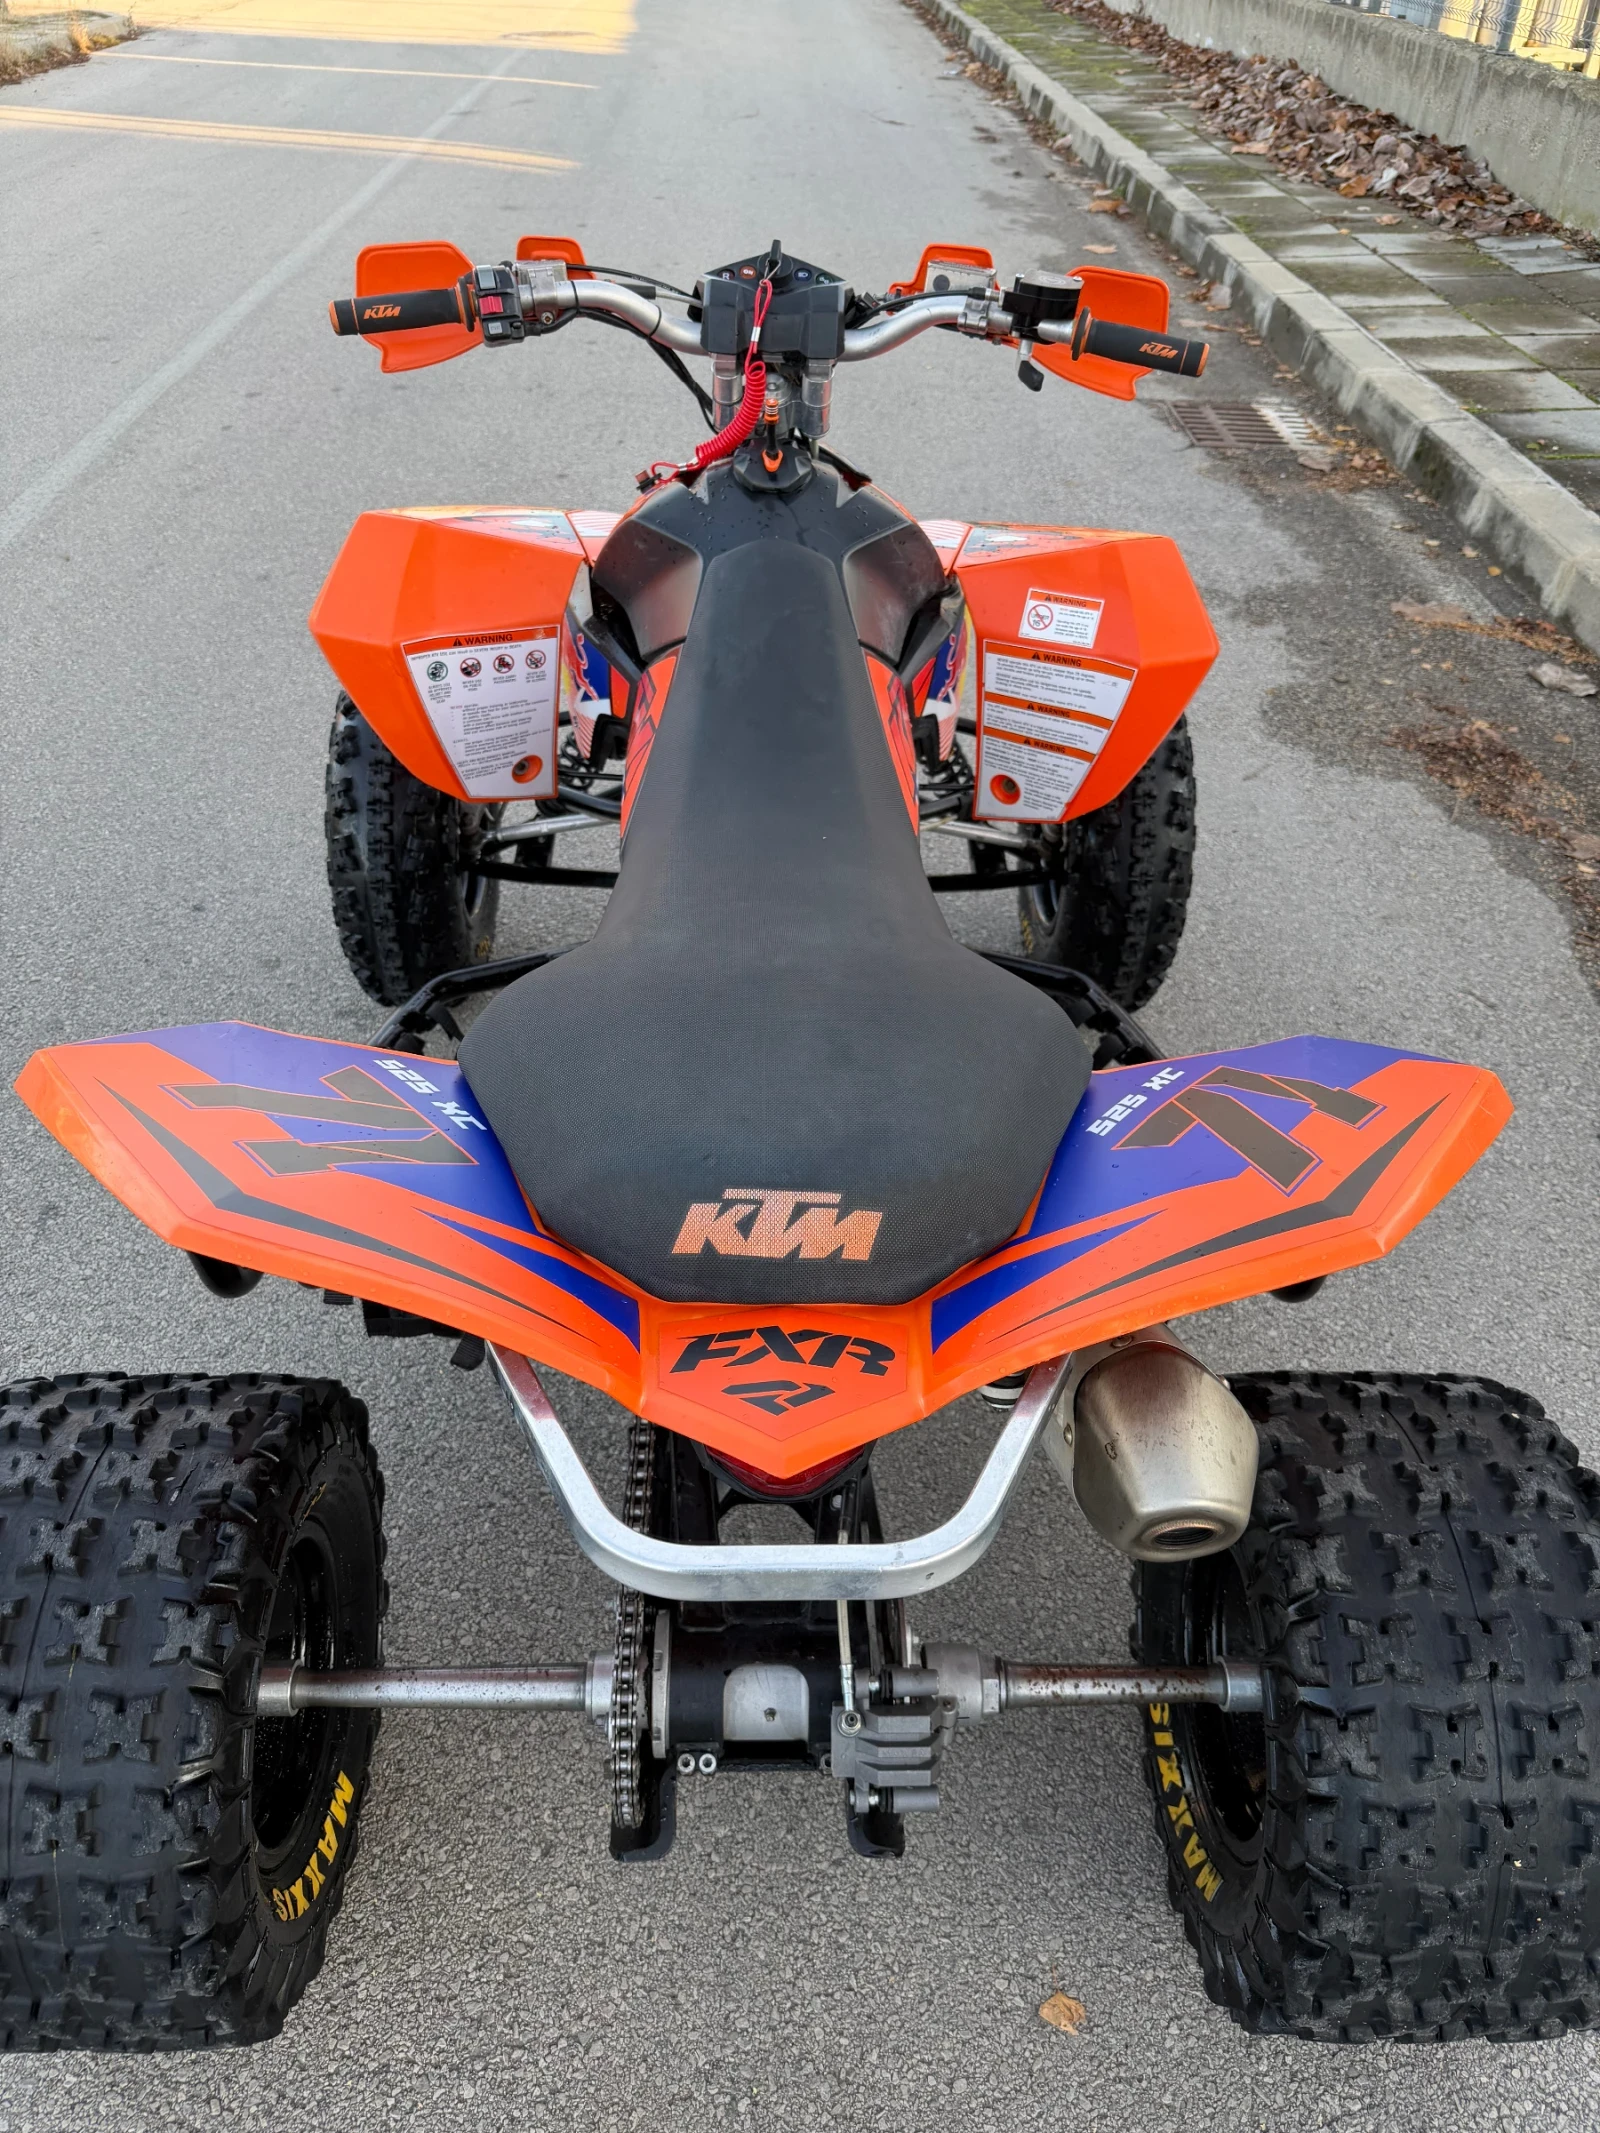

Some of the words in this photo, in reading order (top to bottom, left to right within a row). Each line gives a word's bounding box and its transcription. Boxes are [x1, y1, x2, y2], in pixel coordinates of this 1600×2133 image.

[722, 272, 730, 280] R
[363, 304, 401, 320] KTM
[1139, 341, 1178, 359] KTM
[1052, 597, 1087, 608] WARNING
[464, 634, 513, 646] WARNING
[1043, 654, 1082, 667] WARNING
[1037, 705, 1070, 718] WARNING
[1034, 741, 1066, 754] WARNING
[373, 1059, 440, 1094] 525
[431, 1101, 487, 1130] XC
[1085, 1094, 1148, 1136] 525
[1141, 1067, 1185, 1091] XC
[672, 1188, 883, 1261] KTM
[669, 1326, 896, 1377] FXR
[272, 1770, 355, 1922] MAXXIS
